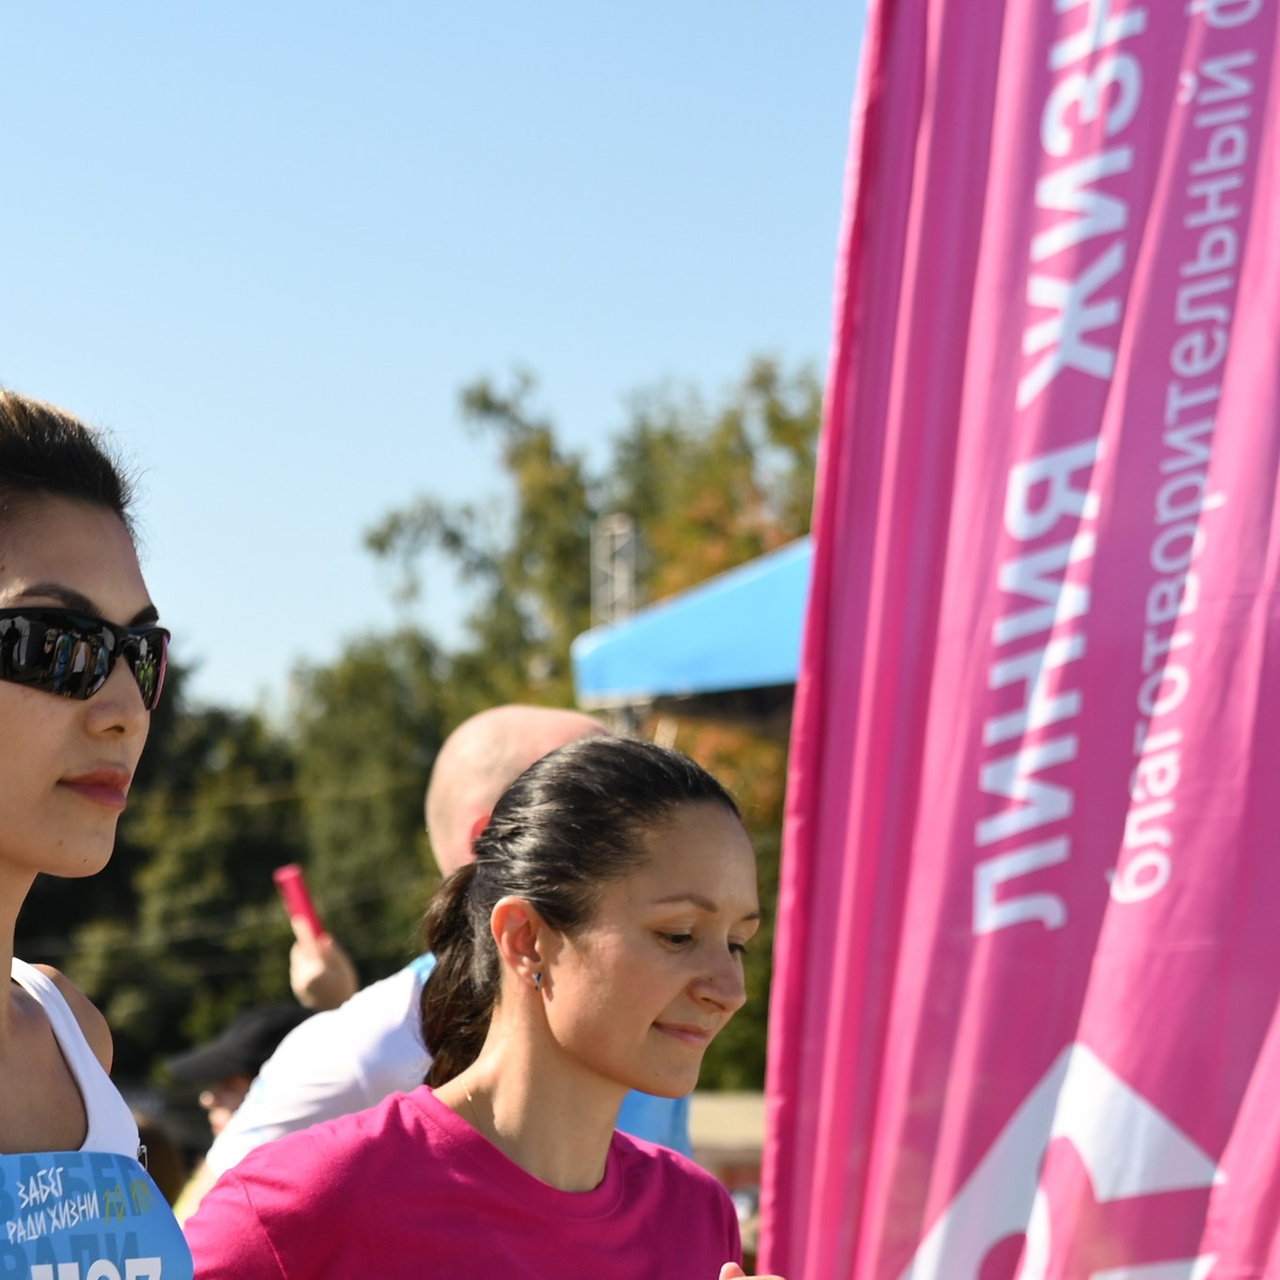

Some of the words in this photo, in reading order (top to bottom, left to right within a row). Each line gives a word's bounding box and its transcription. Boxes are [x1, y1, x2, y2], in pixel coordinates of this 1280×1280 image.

[1104, 50, 1260, 906] благотворительный
[972, 436, 1102, 936] ЛИНИЯ
[6, 1216, 46, 1245] РАДИ
[51, 1190, 100, 1234] ЖИЗНИ
[103, 1185, 126, 1225] 10
[16, 1167, 65, 1210] ЗАБЕГ
